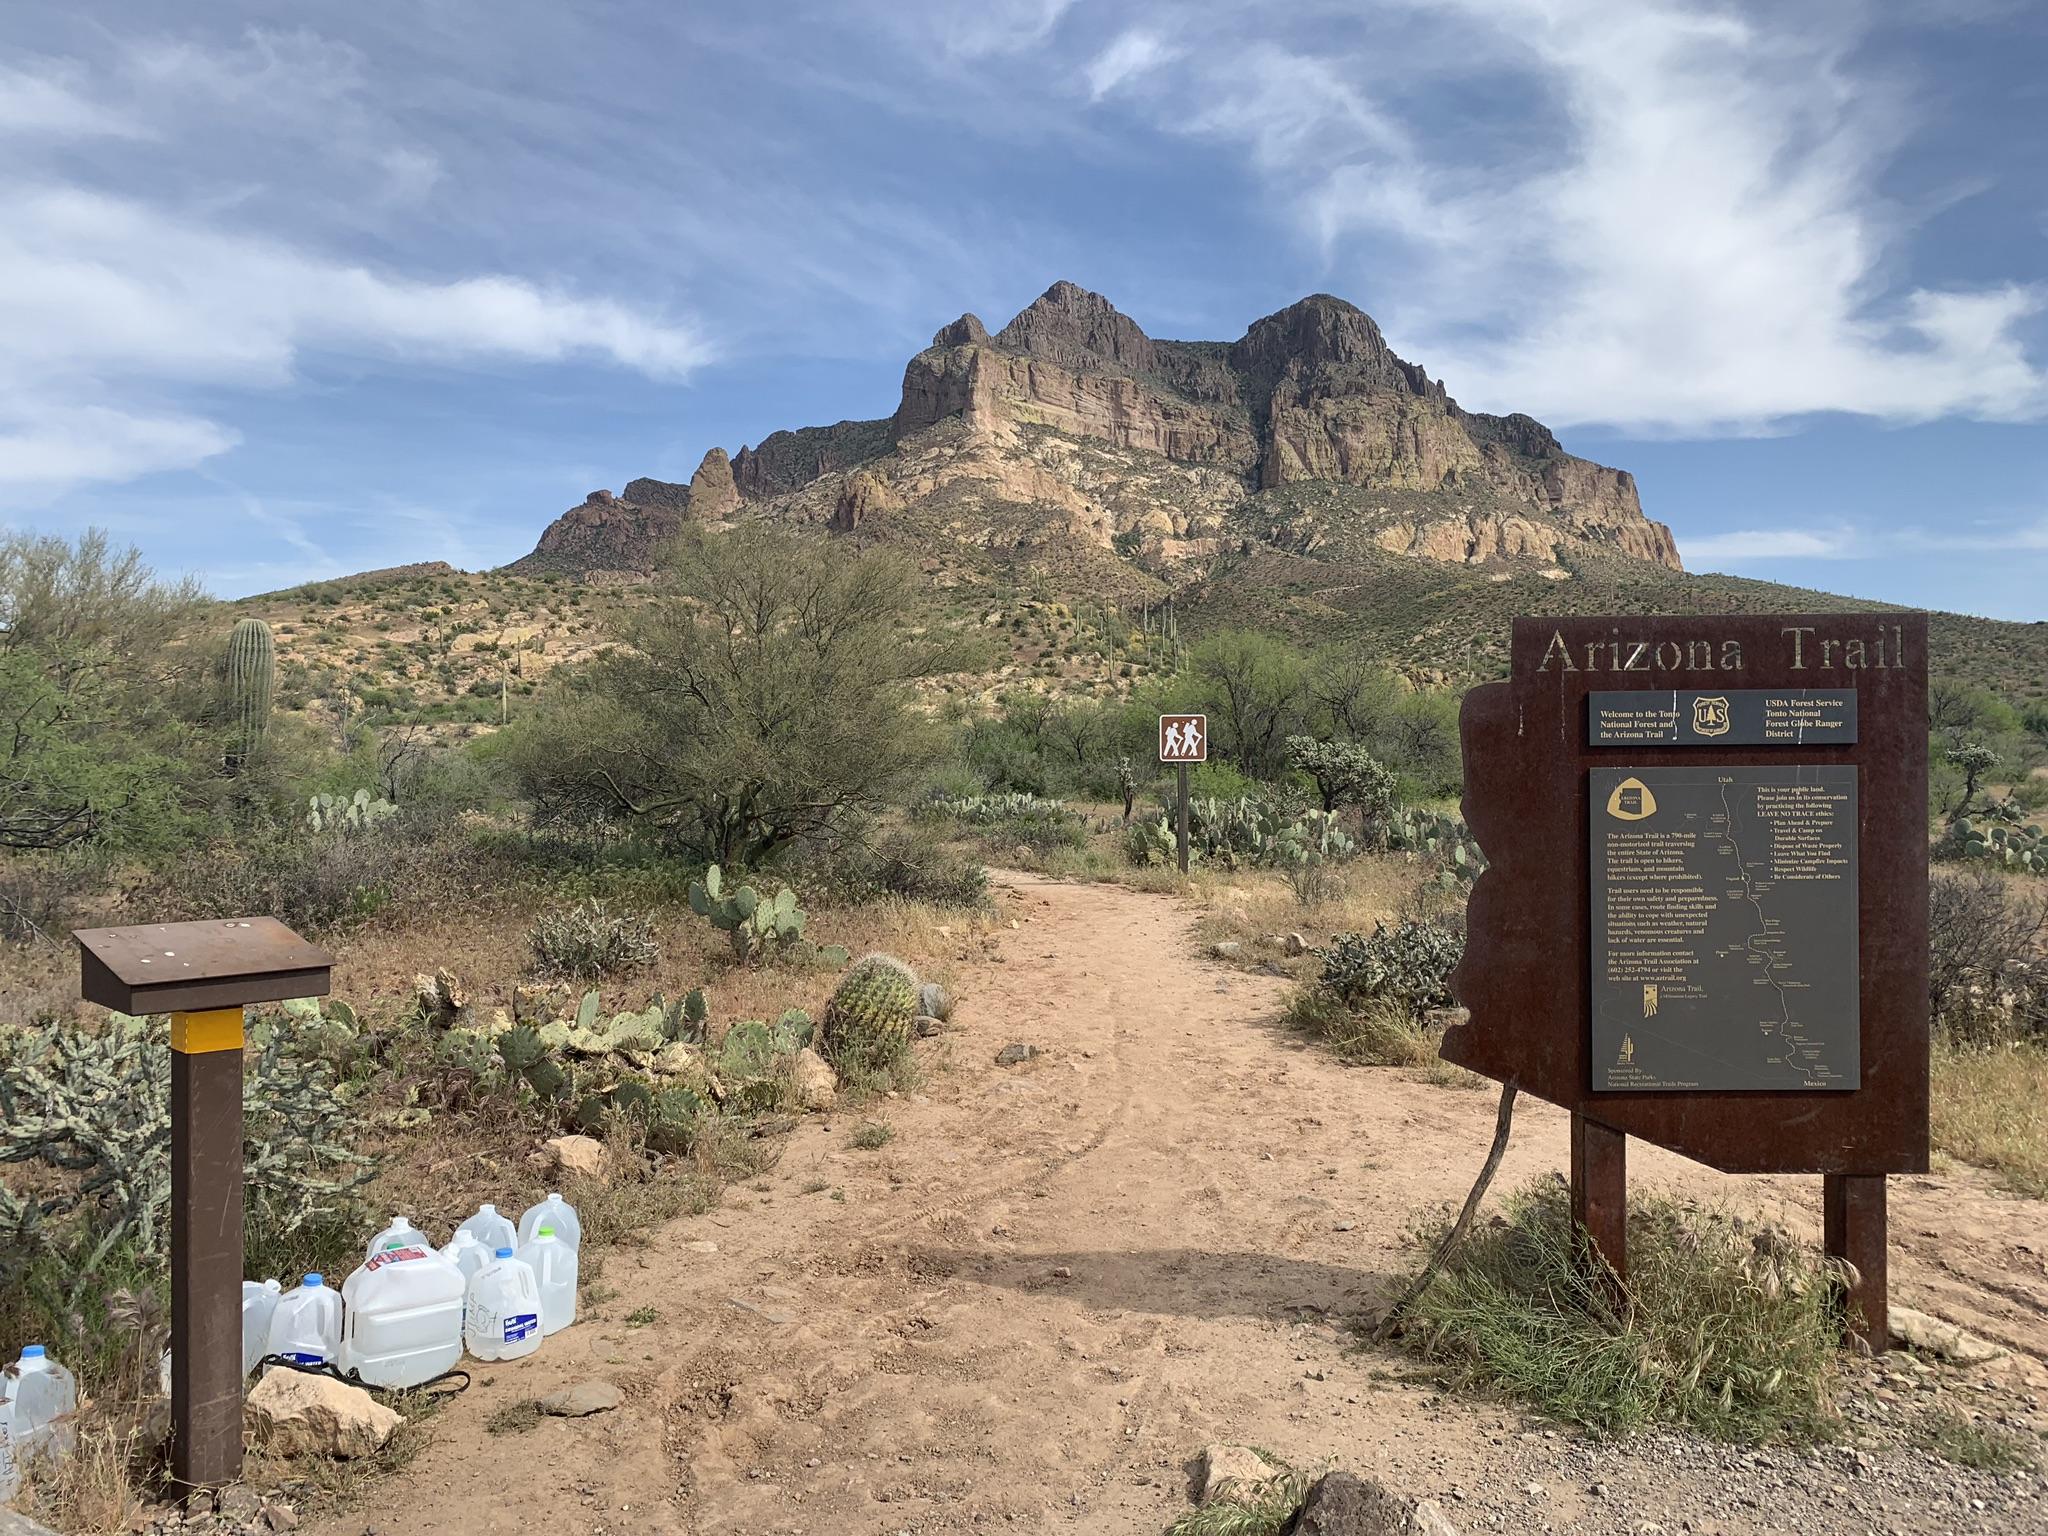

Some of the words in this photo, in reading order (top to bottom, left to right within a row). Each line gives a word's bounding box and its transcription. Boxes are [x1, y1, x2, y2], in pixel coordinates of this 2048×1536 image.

[1535, 627, 1744, 672] Arizona
[1781, 624, 1905, 670] Trail
[1699, 709, 1707, 722] U
[1717, 709, 1724, 722] S
[1815, 720, 1843, 728] Ranger
